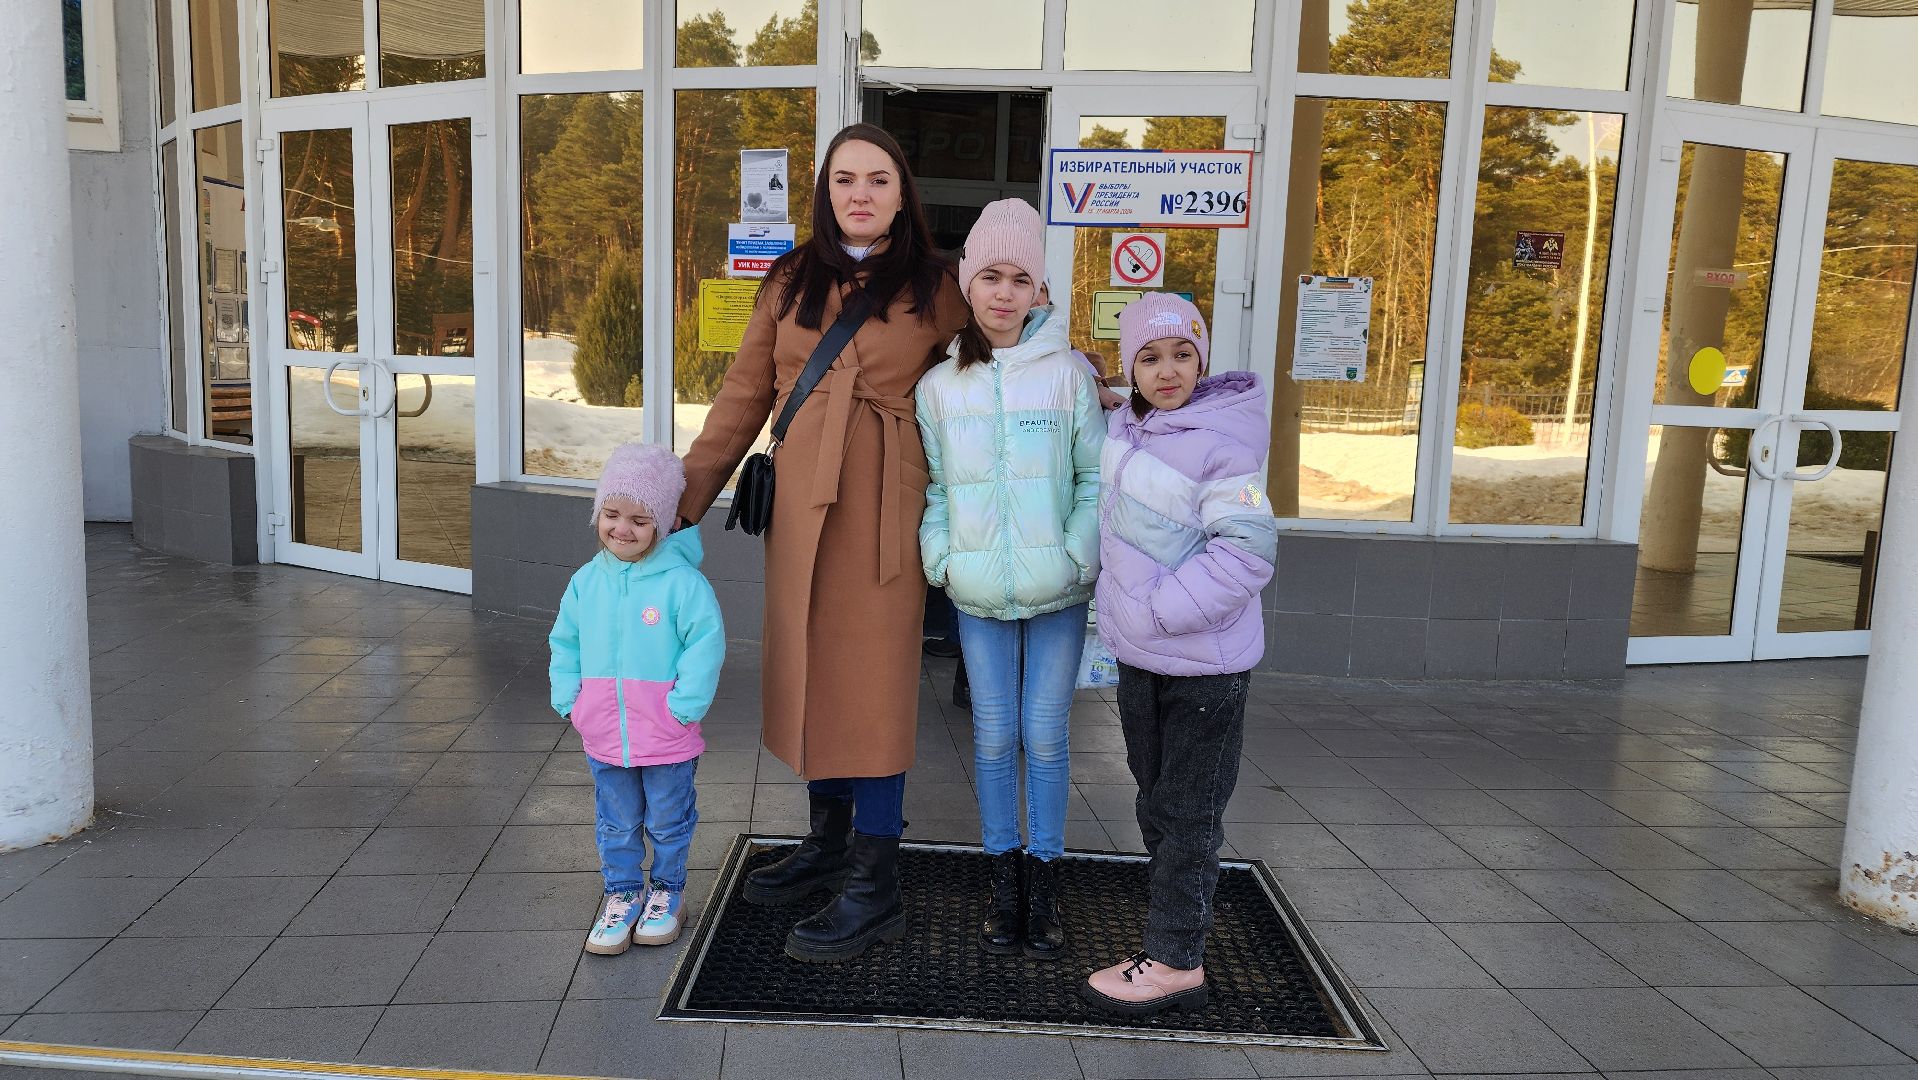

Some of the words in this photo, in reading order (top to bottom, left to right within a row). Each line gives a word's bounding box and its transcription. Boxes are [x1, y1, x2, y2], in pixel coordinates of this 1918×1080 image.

[1059, 159, 1176, 174] ИЗБИРАТЕЛЬНЫЙ
[1180, 161, 1242, 175] УЧАСТОК
[1094, 191, 1140, 199] ПРЕЗИДЕНТА
[1706, 272, 1735, 284] ВХОД
